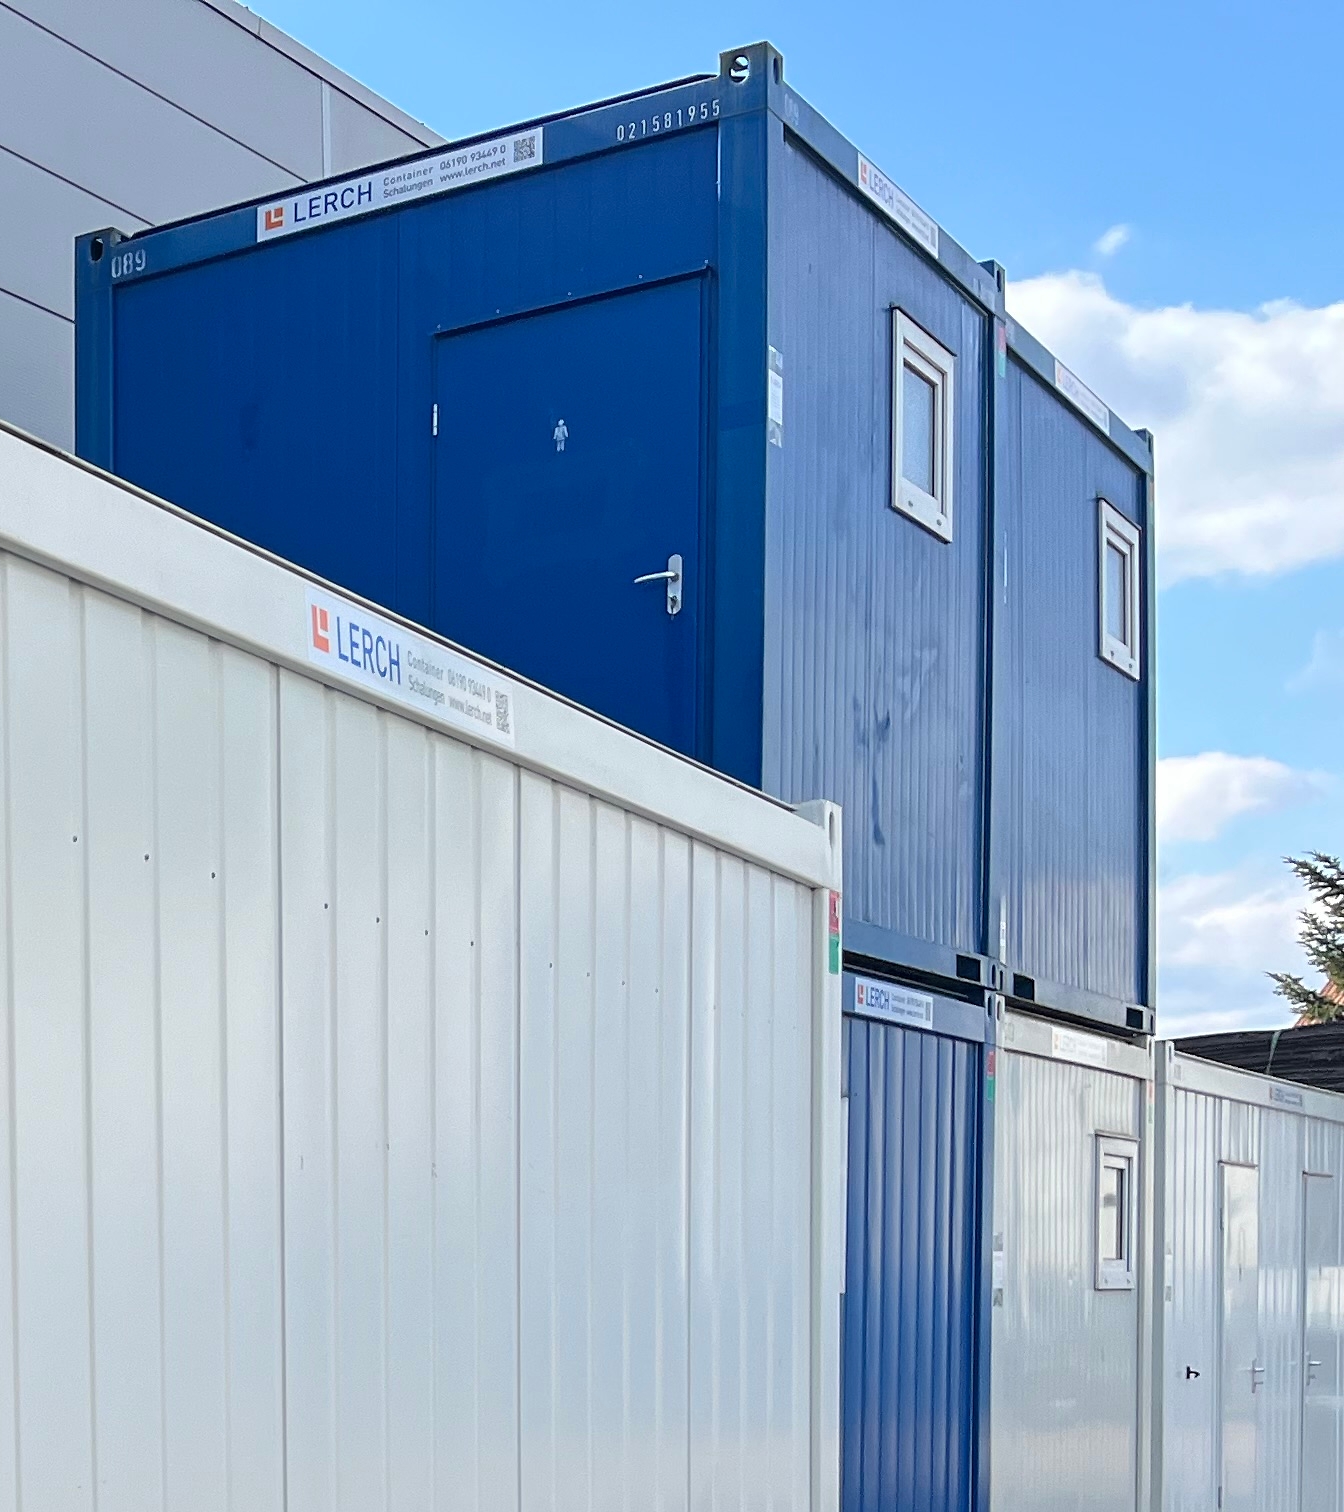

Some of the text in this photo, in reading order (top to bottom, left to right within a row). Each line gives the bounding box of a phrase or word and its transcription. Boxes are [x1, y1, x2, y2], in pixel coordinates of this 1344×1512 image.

[616, 99, 720, 141] 021581955
[383, 144, 507, 187] Container 06190 93449 0
[383, 157, 506, 199] Schalungen www.lerch.net
[294, 181, 373, 223] LERCH
[336, 616, 401, 685] LERCH
[866, 985, 890, 1010] LERCH
